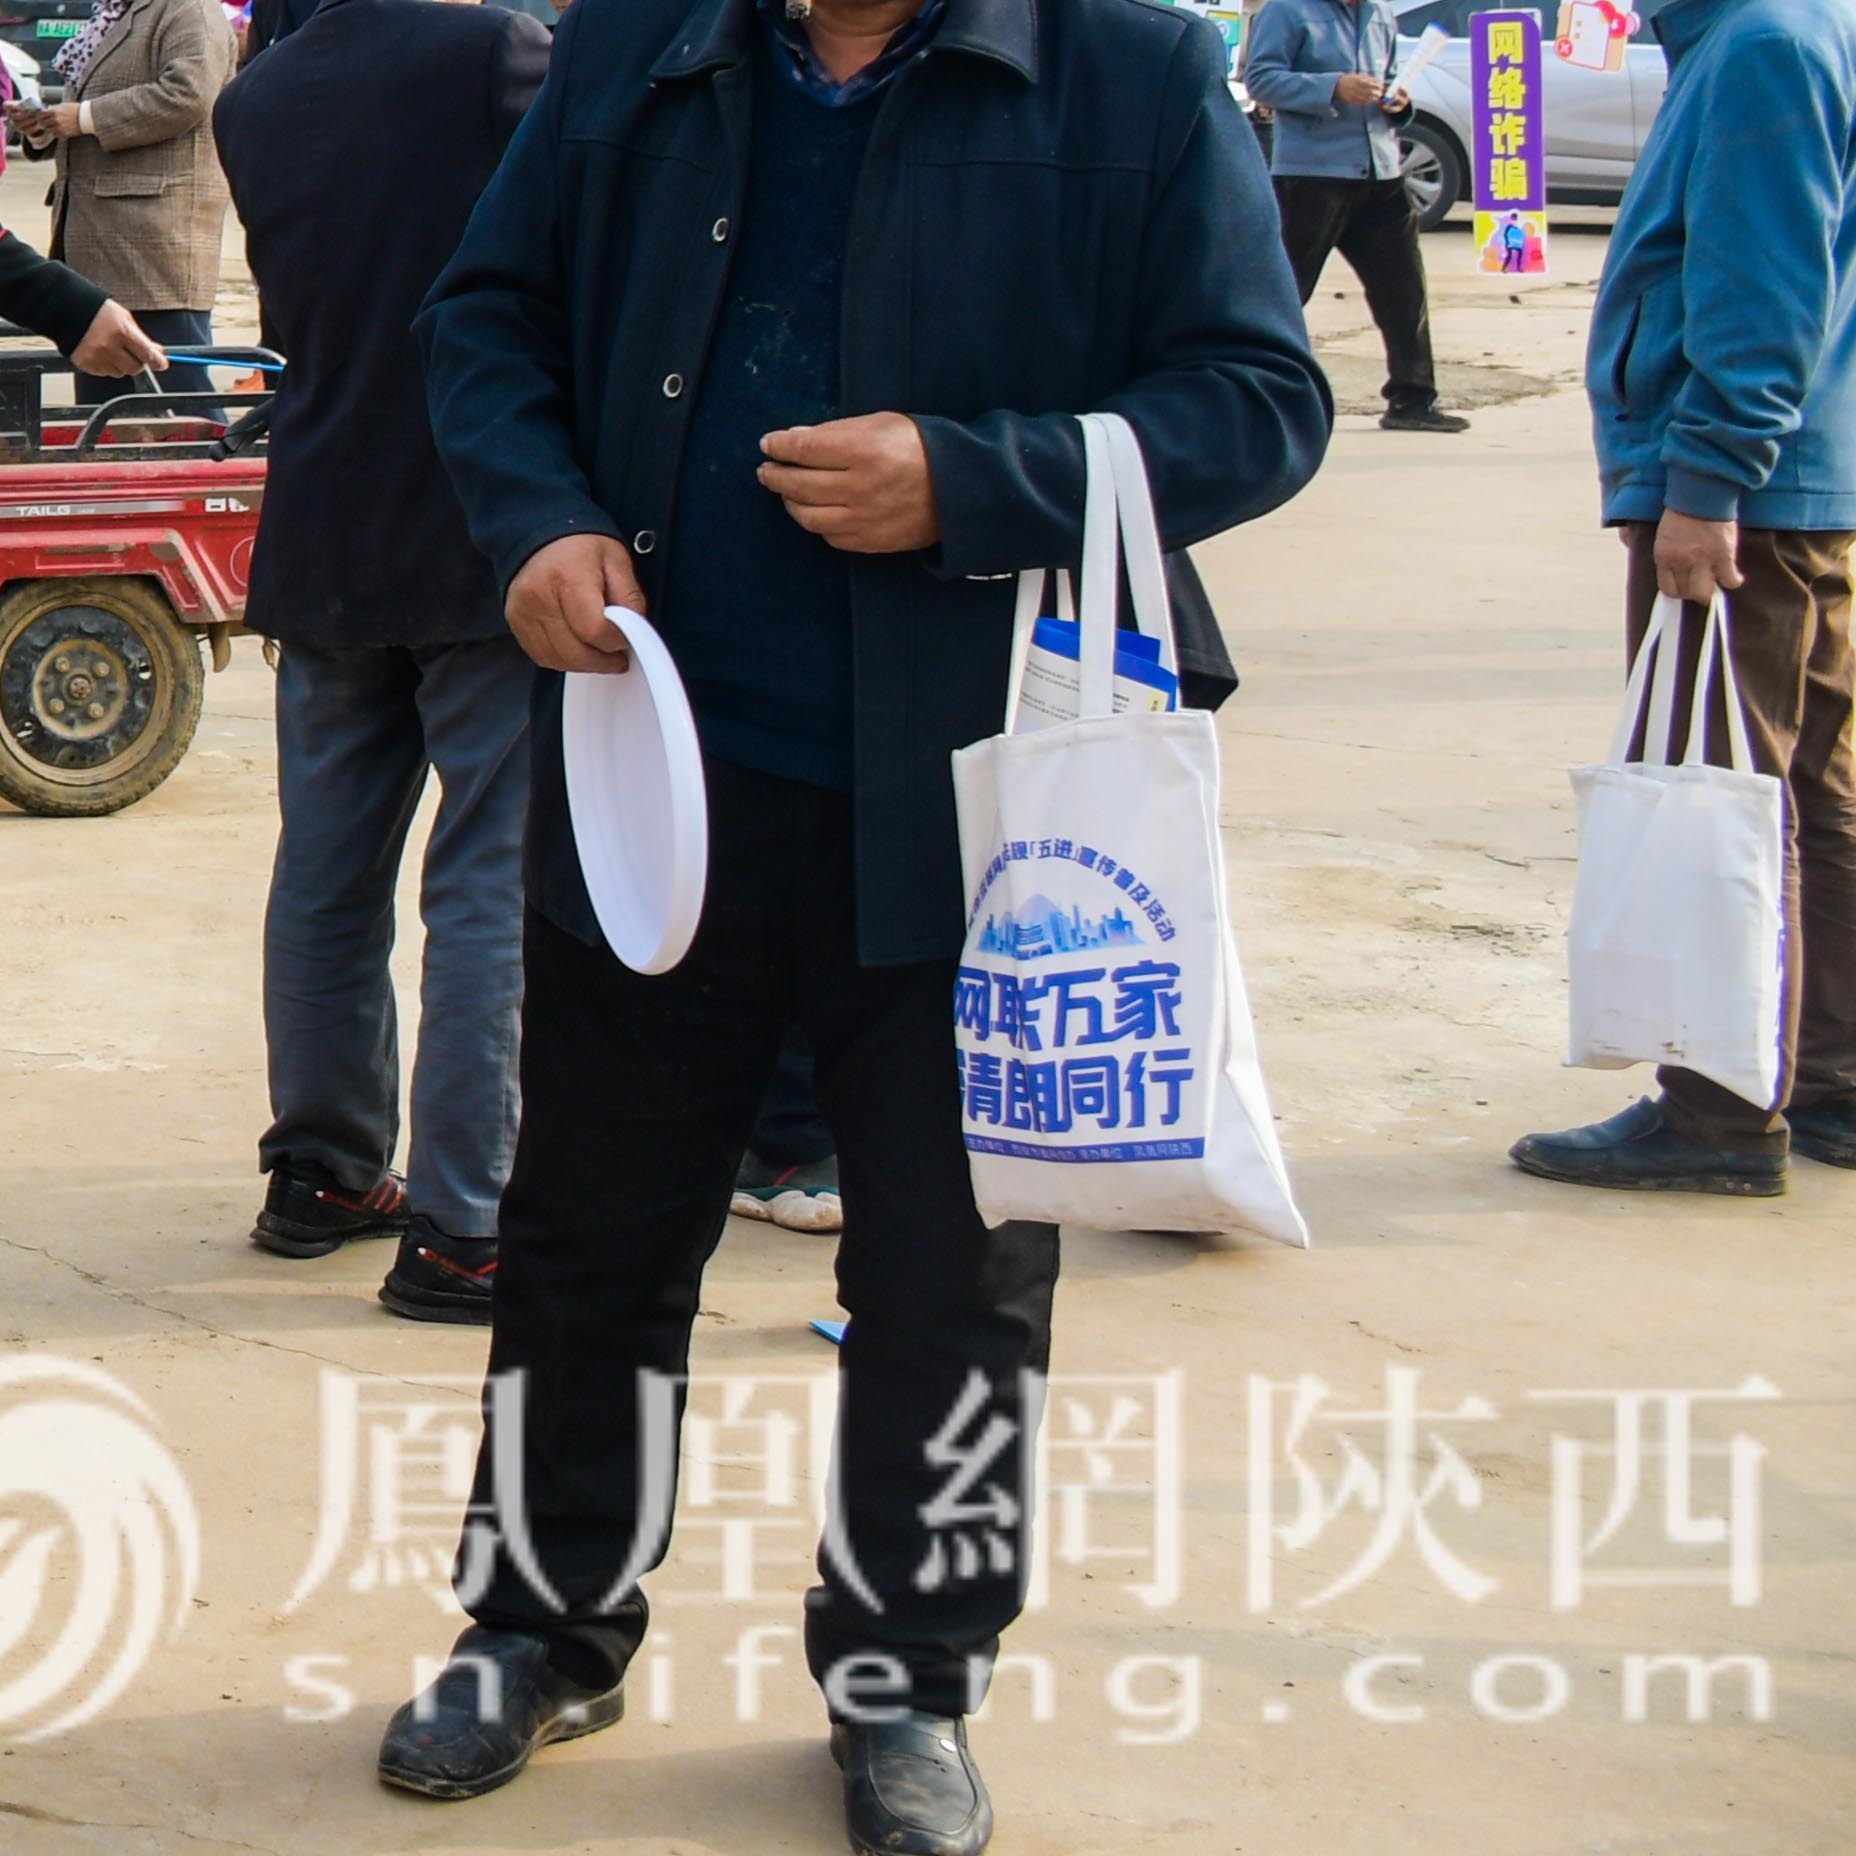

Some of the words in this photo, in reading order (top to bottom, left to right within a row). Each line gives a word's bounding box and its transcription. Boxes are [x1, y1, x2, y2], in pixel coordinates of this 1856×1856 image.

[1488, 21, 1528, 201] 网络诈骗
[955, 959, 1182, 1052] 网联万家
[958, 1047, 1195, 1134] 清朗同行
